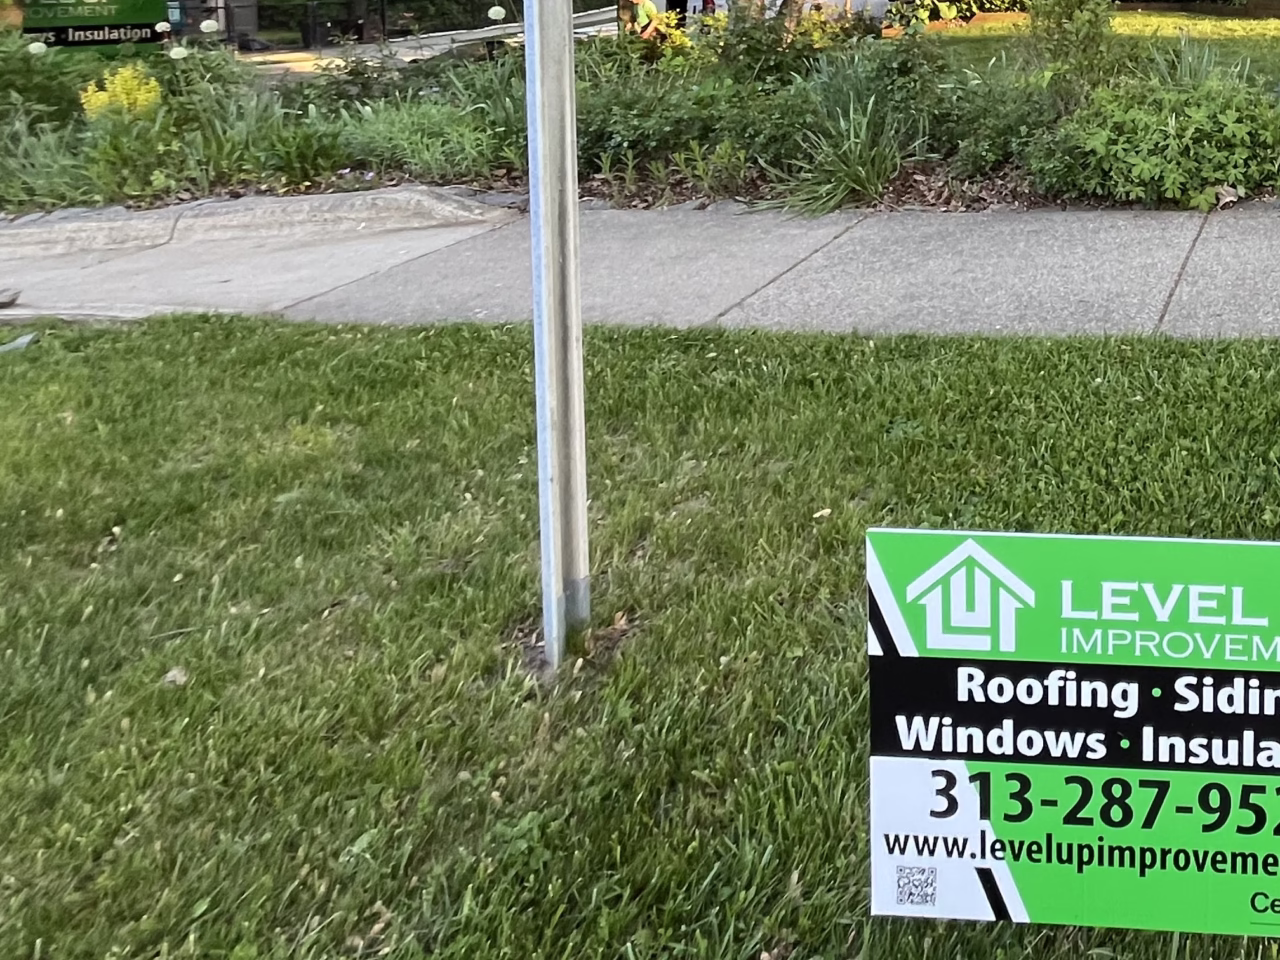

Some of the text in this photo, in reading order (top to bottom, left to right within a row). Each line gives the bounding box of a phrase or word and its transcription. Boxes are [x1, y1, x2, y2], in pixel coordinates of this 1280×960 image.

[68, 26, 151, 41] Insulation
[1060, 580, 1269, 627] LEVEL
[957, 666, 1139, 718] Roofing
[895, 715, 1107, 760] Windows
